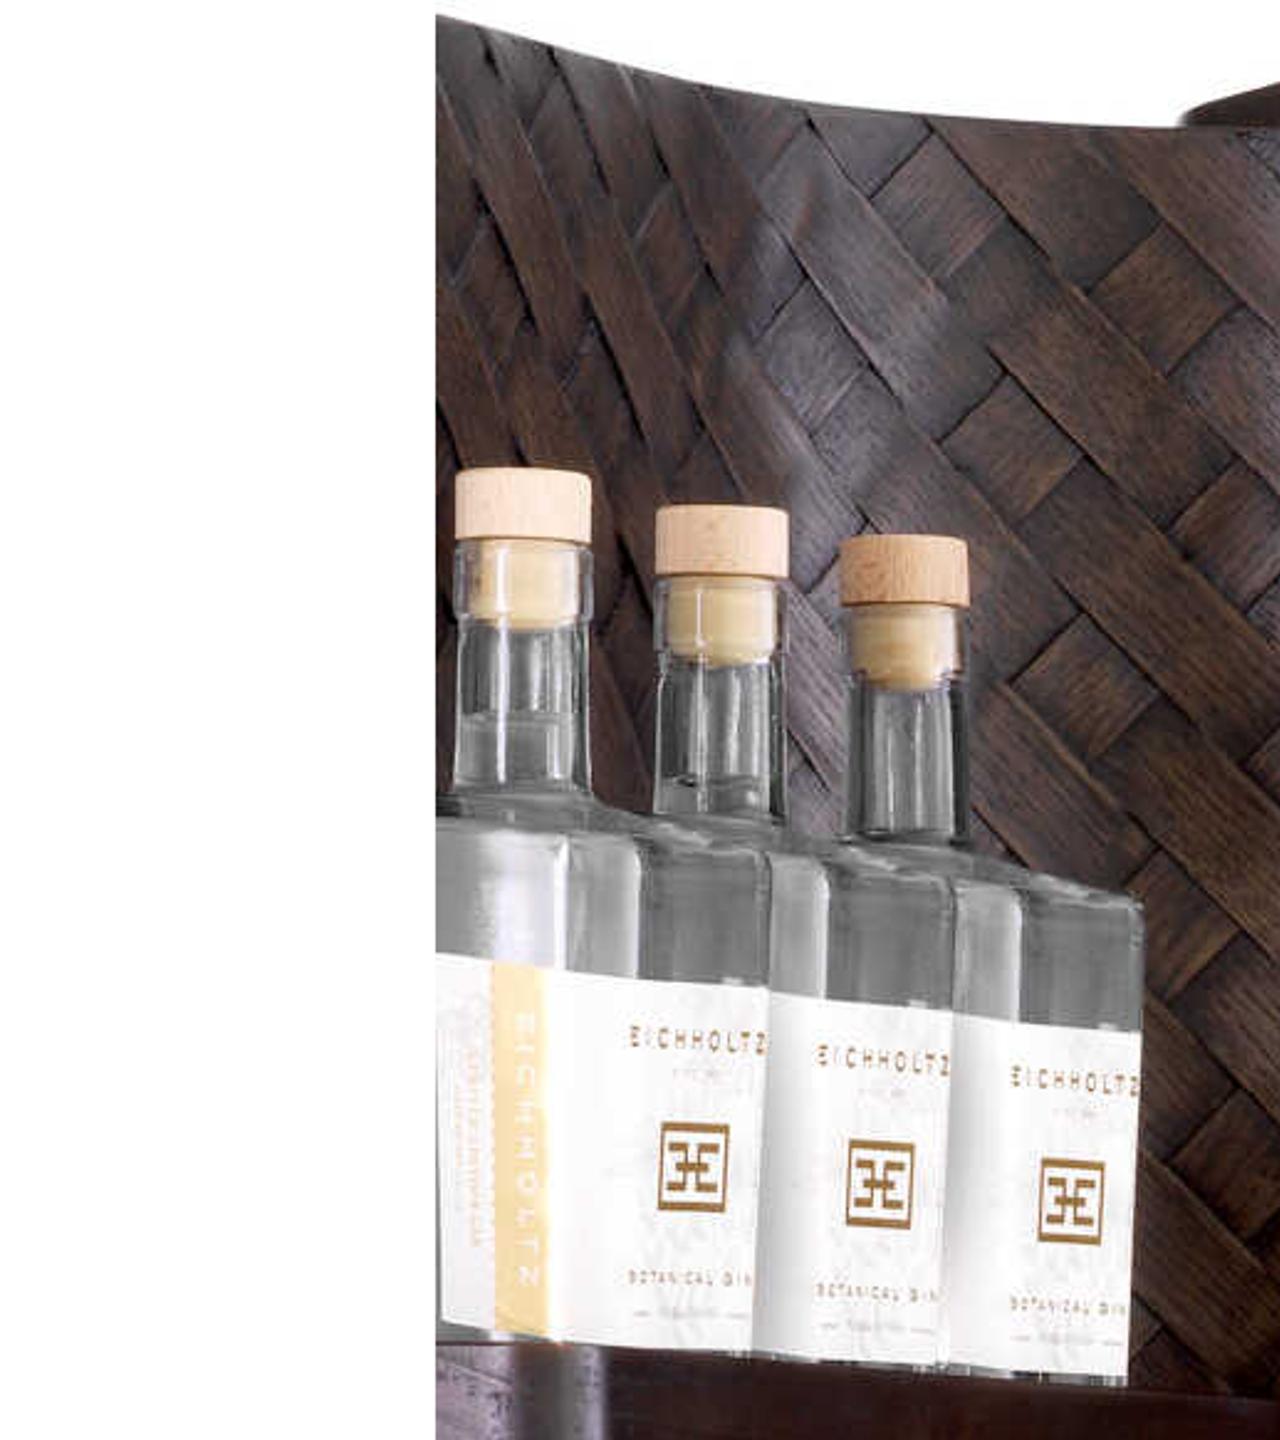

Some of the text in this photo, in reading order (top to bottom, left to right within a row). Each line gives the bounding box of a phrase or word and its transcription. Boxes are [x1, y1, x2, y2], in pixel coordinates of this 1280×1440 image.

[630, 1025, 767, 1055] EICHHOLTZ
[818, 1044, 949, 1076] EICHHOLTZ
[1010, 1064, 1138, 1098] EICHHOLTZ
